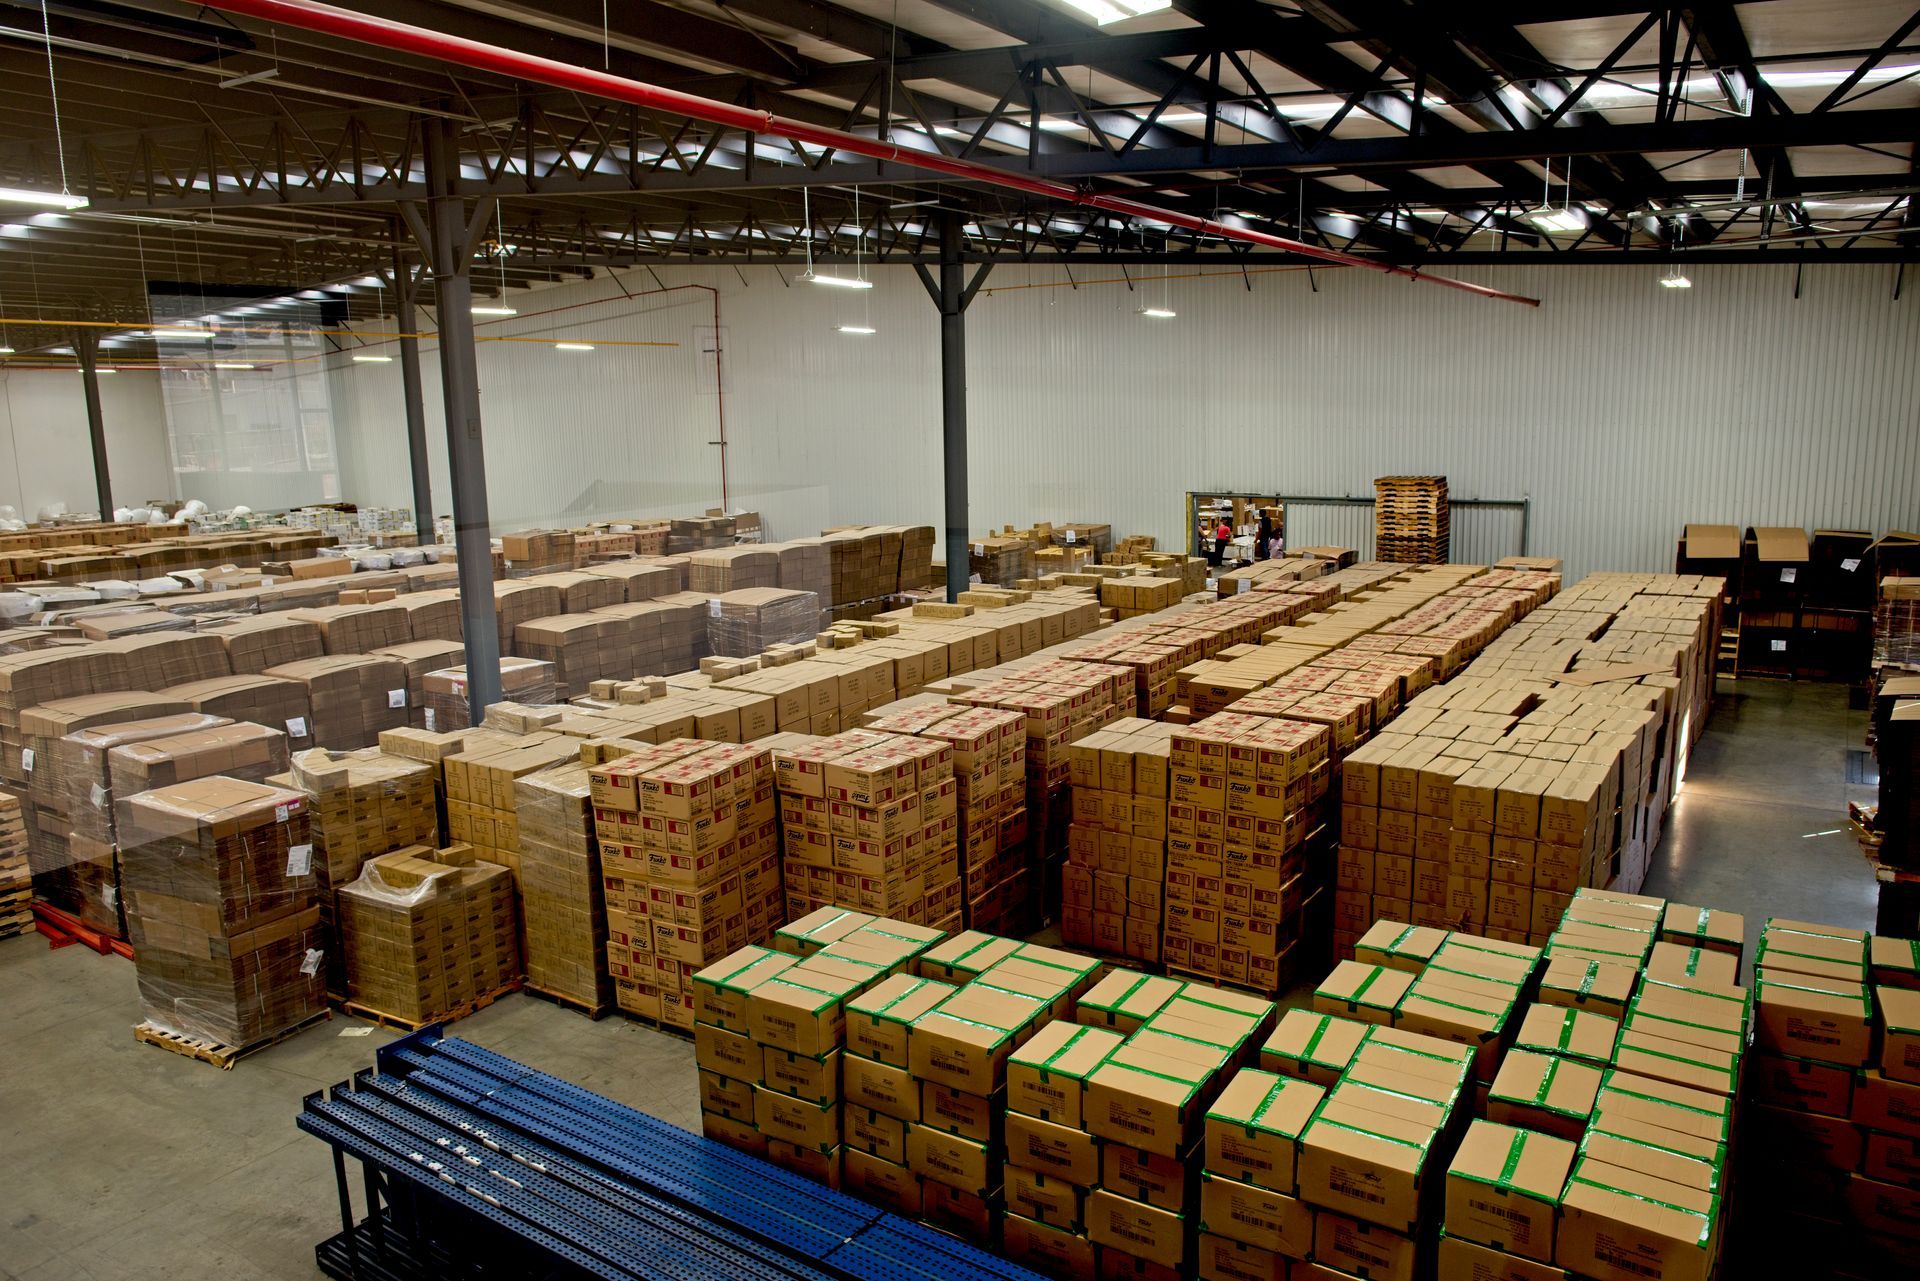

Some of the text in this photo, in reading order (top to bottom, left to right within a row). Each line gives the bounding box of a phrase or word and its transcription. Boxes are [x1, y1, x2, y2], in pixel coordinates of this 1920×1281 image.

[778, 759, 795, 770] Funko
[1176, 773, 1196, 785] Funko
[641, 781, 659, 792] Funko
[1229, 782, 1251, 794] Funko
[837, 839, 856, 850] Funko
[1171, 839, 1191, 850] Funko
[649, 854, 666, 865] Funko
[1226, 850, 1248, 861] Funko
[1169, 905, 1189, 916] Funko
[1224, 917, 1245, 928] Funko
[656, 925, 675, 937] Funko
[663, 993, 681, 1005] Funko
